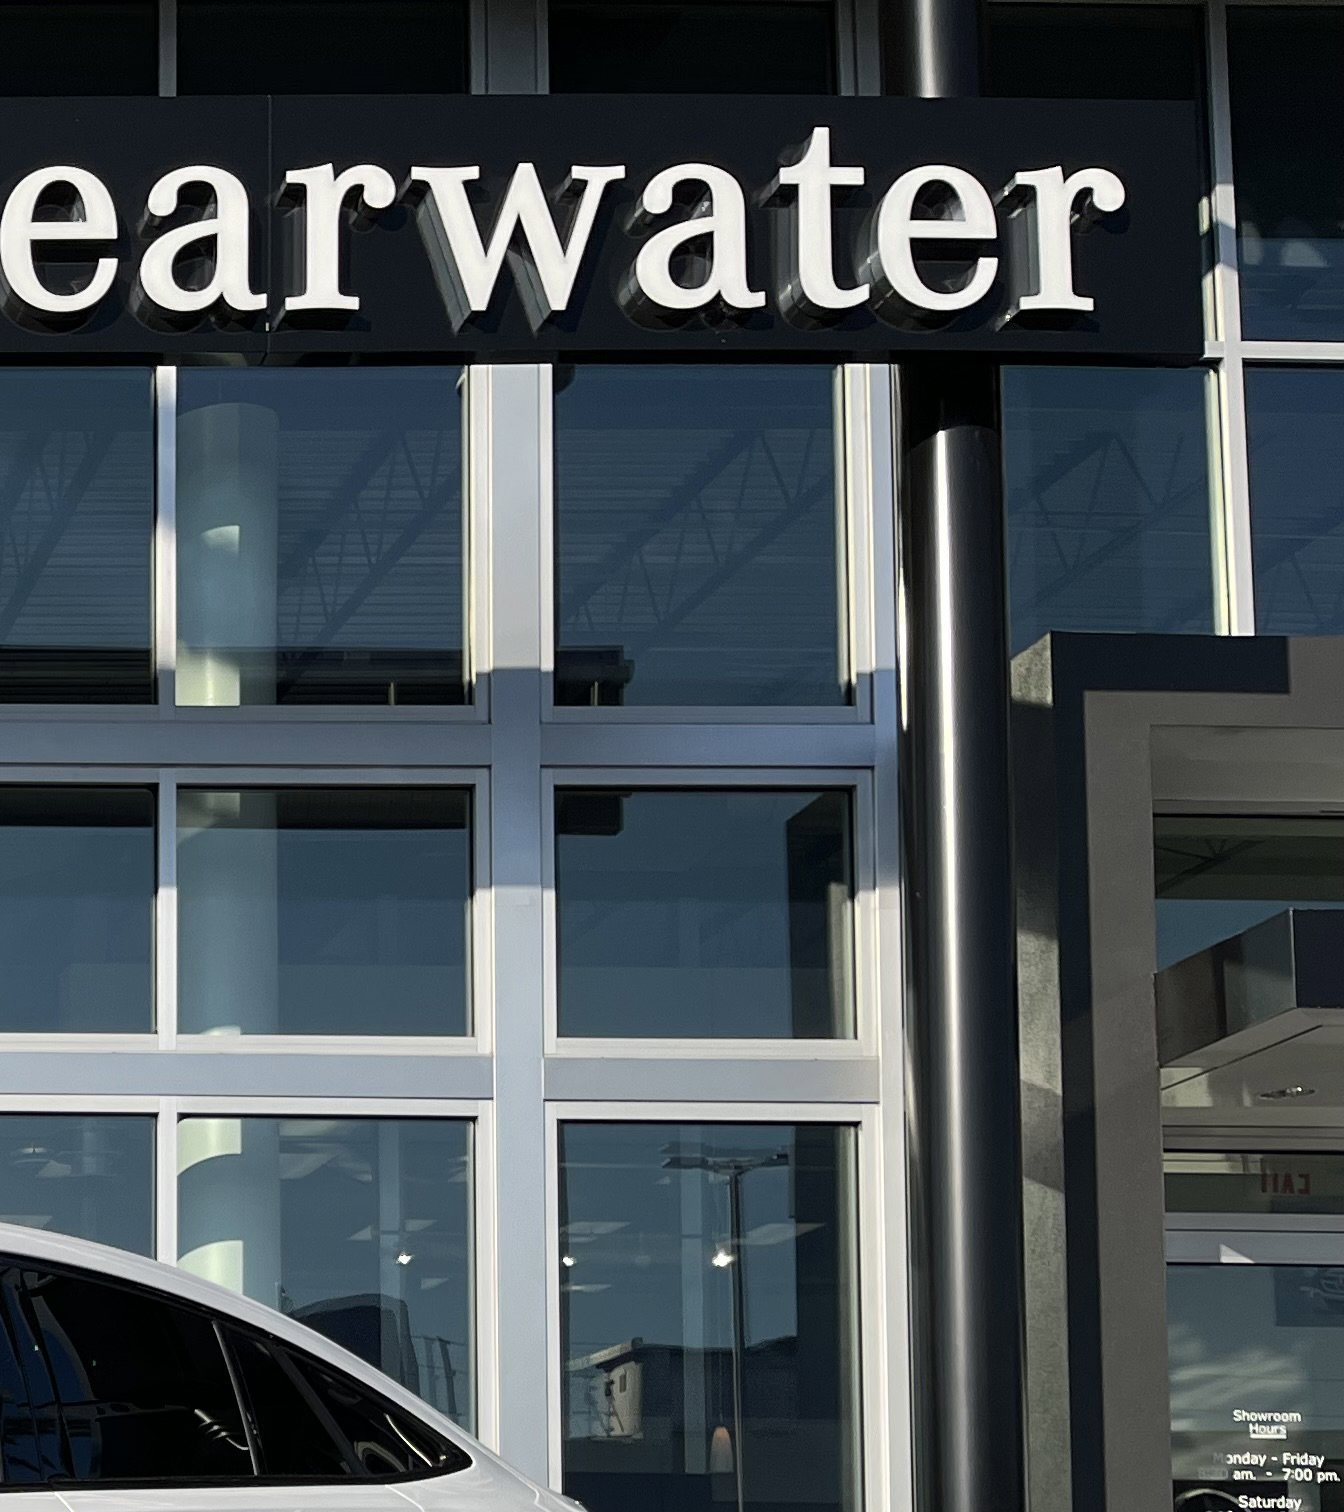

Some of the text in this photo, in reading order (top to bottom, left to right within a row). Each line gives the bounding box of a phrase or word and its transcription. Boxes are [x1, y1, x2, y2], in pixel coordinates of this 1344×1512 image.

[1232, 1409, 1302, 1422] Showroom
[1248, 1422, 1288, 1435] Hours
[1213, 1451, 1267, 1467] Monday
[1282, 1452, 1325, 1468] Friday
[1282, 1467, 1313, 1482] 7:00
[1238, 1494, 1302, 1511] Saturday
